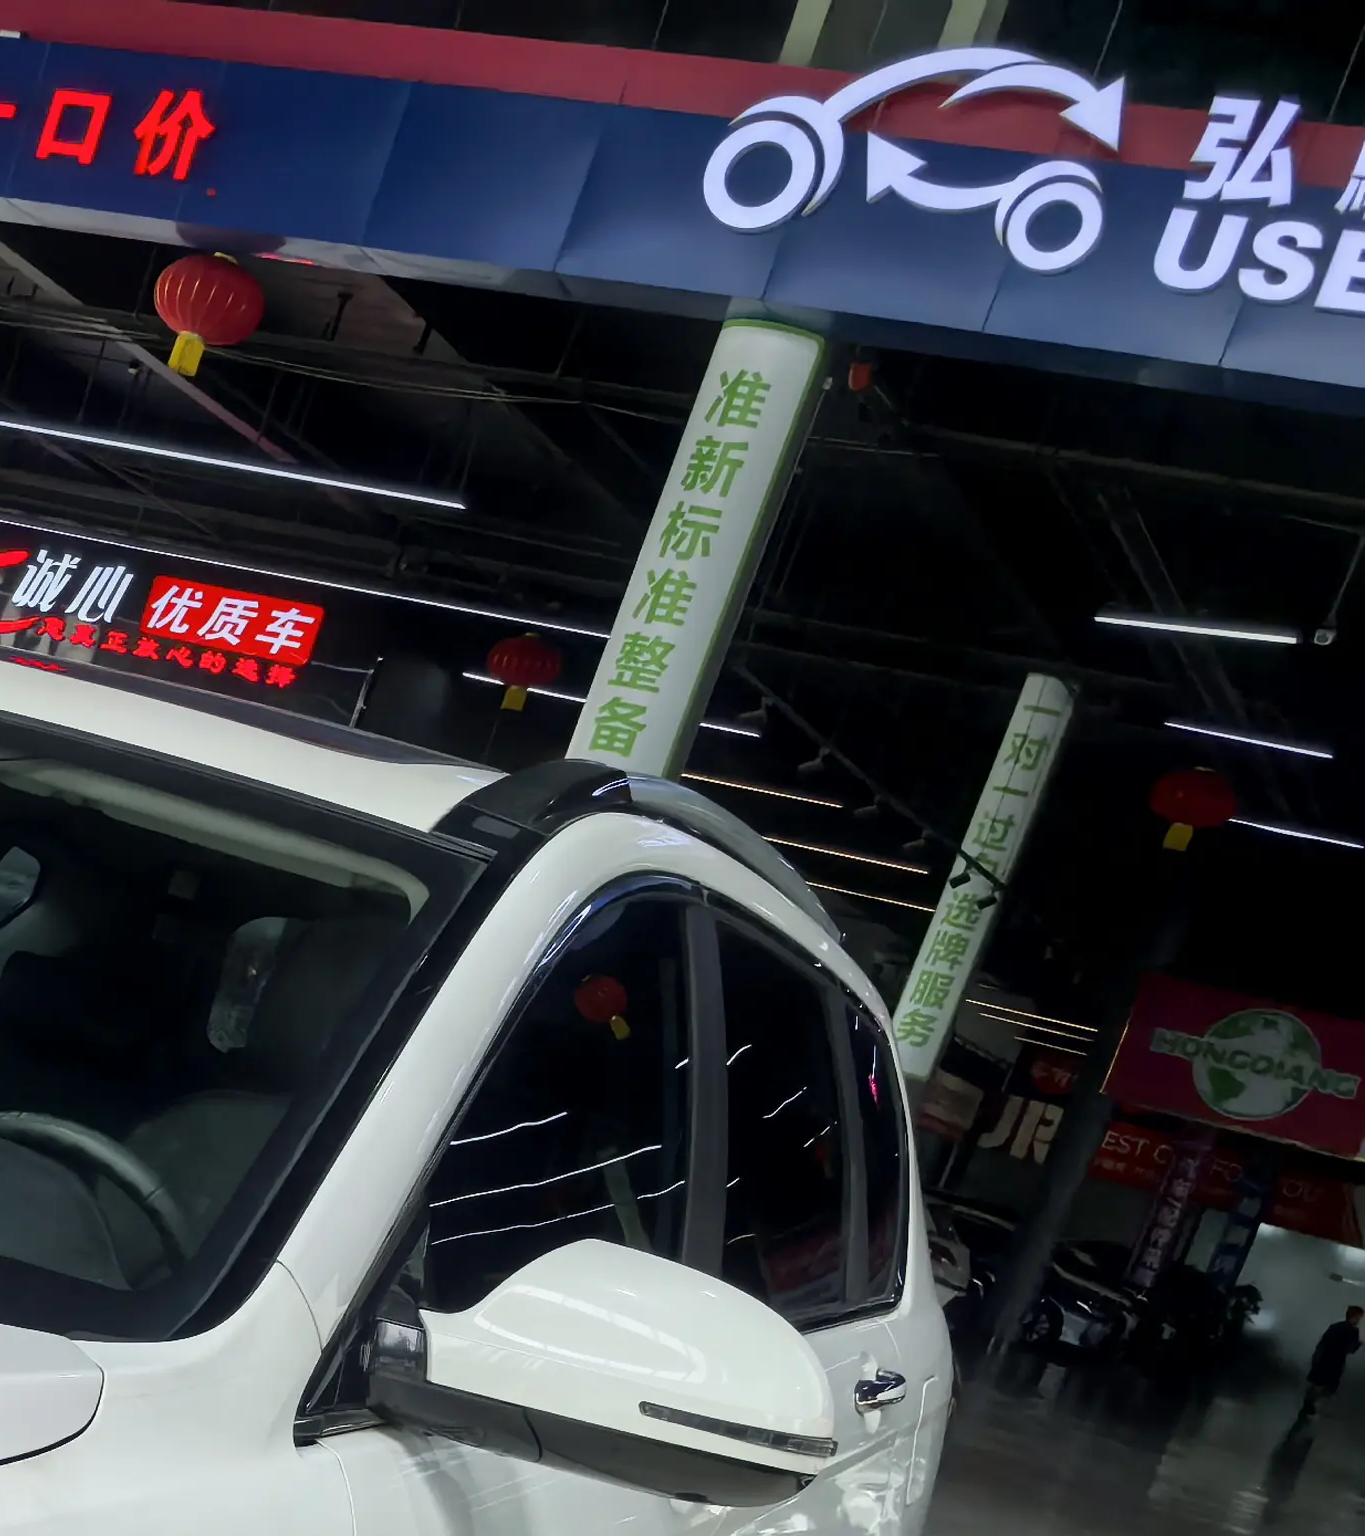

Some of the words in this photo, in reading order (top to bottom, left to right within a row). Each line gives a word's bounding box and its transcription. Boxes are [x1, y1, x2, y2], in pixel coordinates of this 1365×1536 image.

[587, 369, 772, 757] 准新标准整备
[35, 616, 299, 689] 您真正放心的选择
[977, 1095, 1065, 1167] JR
[1100, 1131, 1151, 1164] EST
